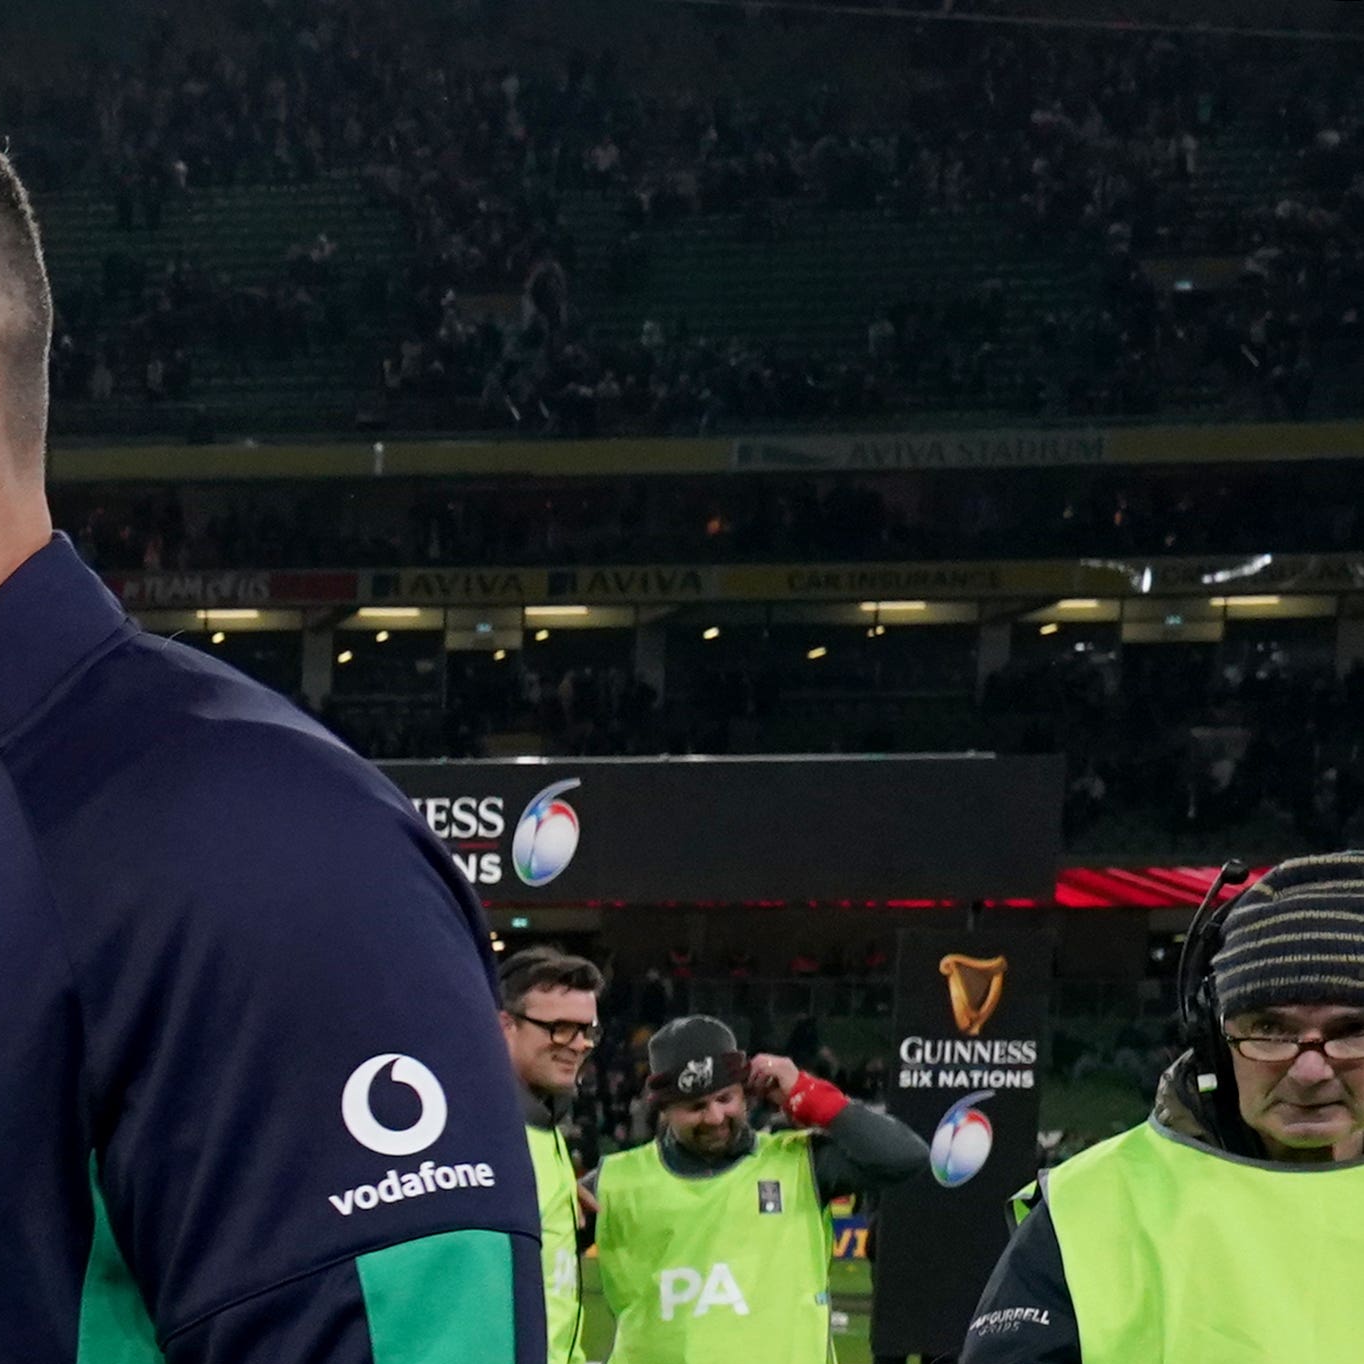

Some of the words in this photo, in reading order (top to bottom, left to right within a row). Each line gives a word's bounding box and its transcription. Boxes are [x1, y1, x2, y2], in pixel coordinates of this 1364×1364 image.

[409, 573, 523, 597] AVIVA
[585, 570, 700, 595] AVIVA
[410, 796, 505, 839] ESS
[899, 1036, 1038, 1065] GUINNESS
[898, 1070, 934, 1089] SIX
[937, 1070, 1035, 1089] NATIONS
[328, 1160, 495, 1216] vodafone
[659, 1262, 751, 1322] PA
